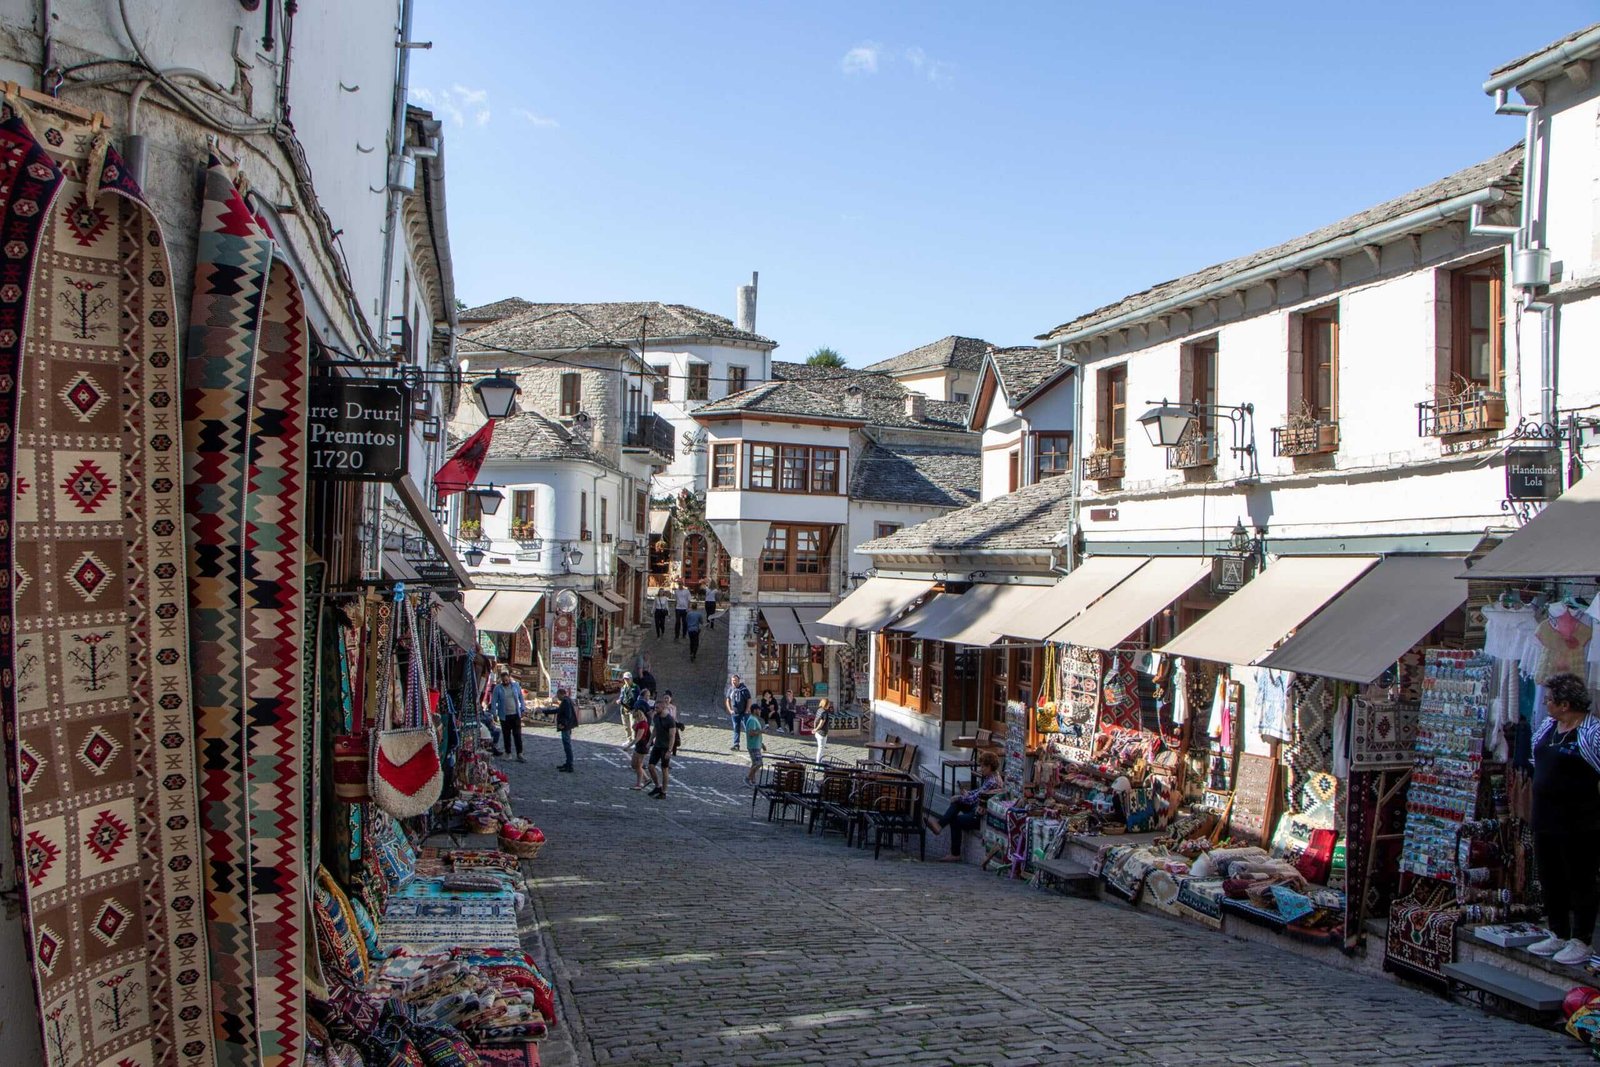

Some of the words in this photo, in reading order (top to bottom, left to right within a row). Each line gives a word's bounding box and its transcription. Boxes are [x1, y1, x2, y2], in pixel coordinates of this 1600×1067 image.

[345, 402, 400, 421] Druri
[310, 423, 396, 446] Premtos
[313, 449, 364, 469] 1720
[1511, 464, 1557, 475] Handmade
[1524, 476, 1543, 486] Lola
